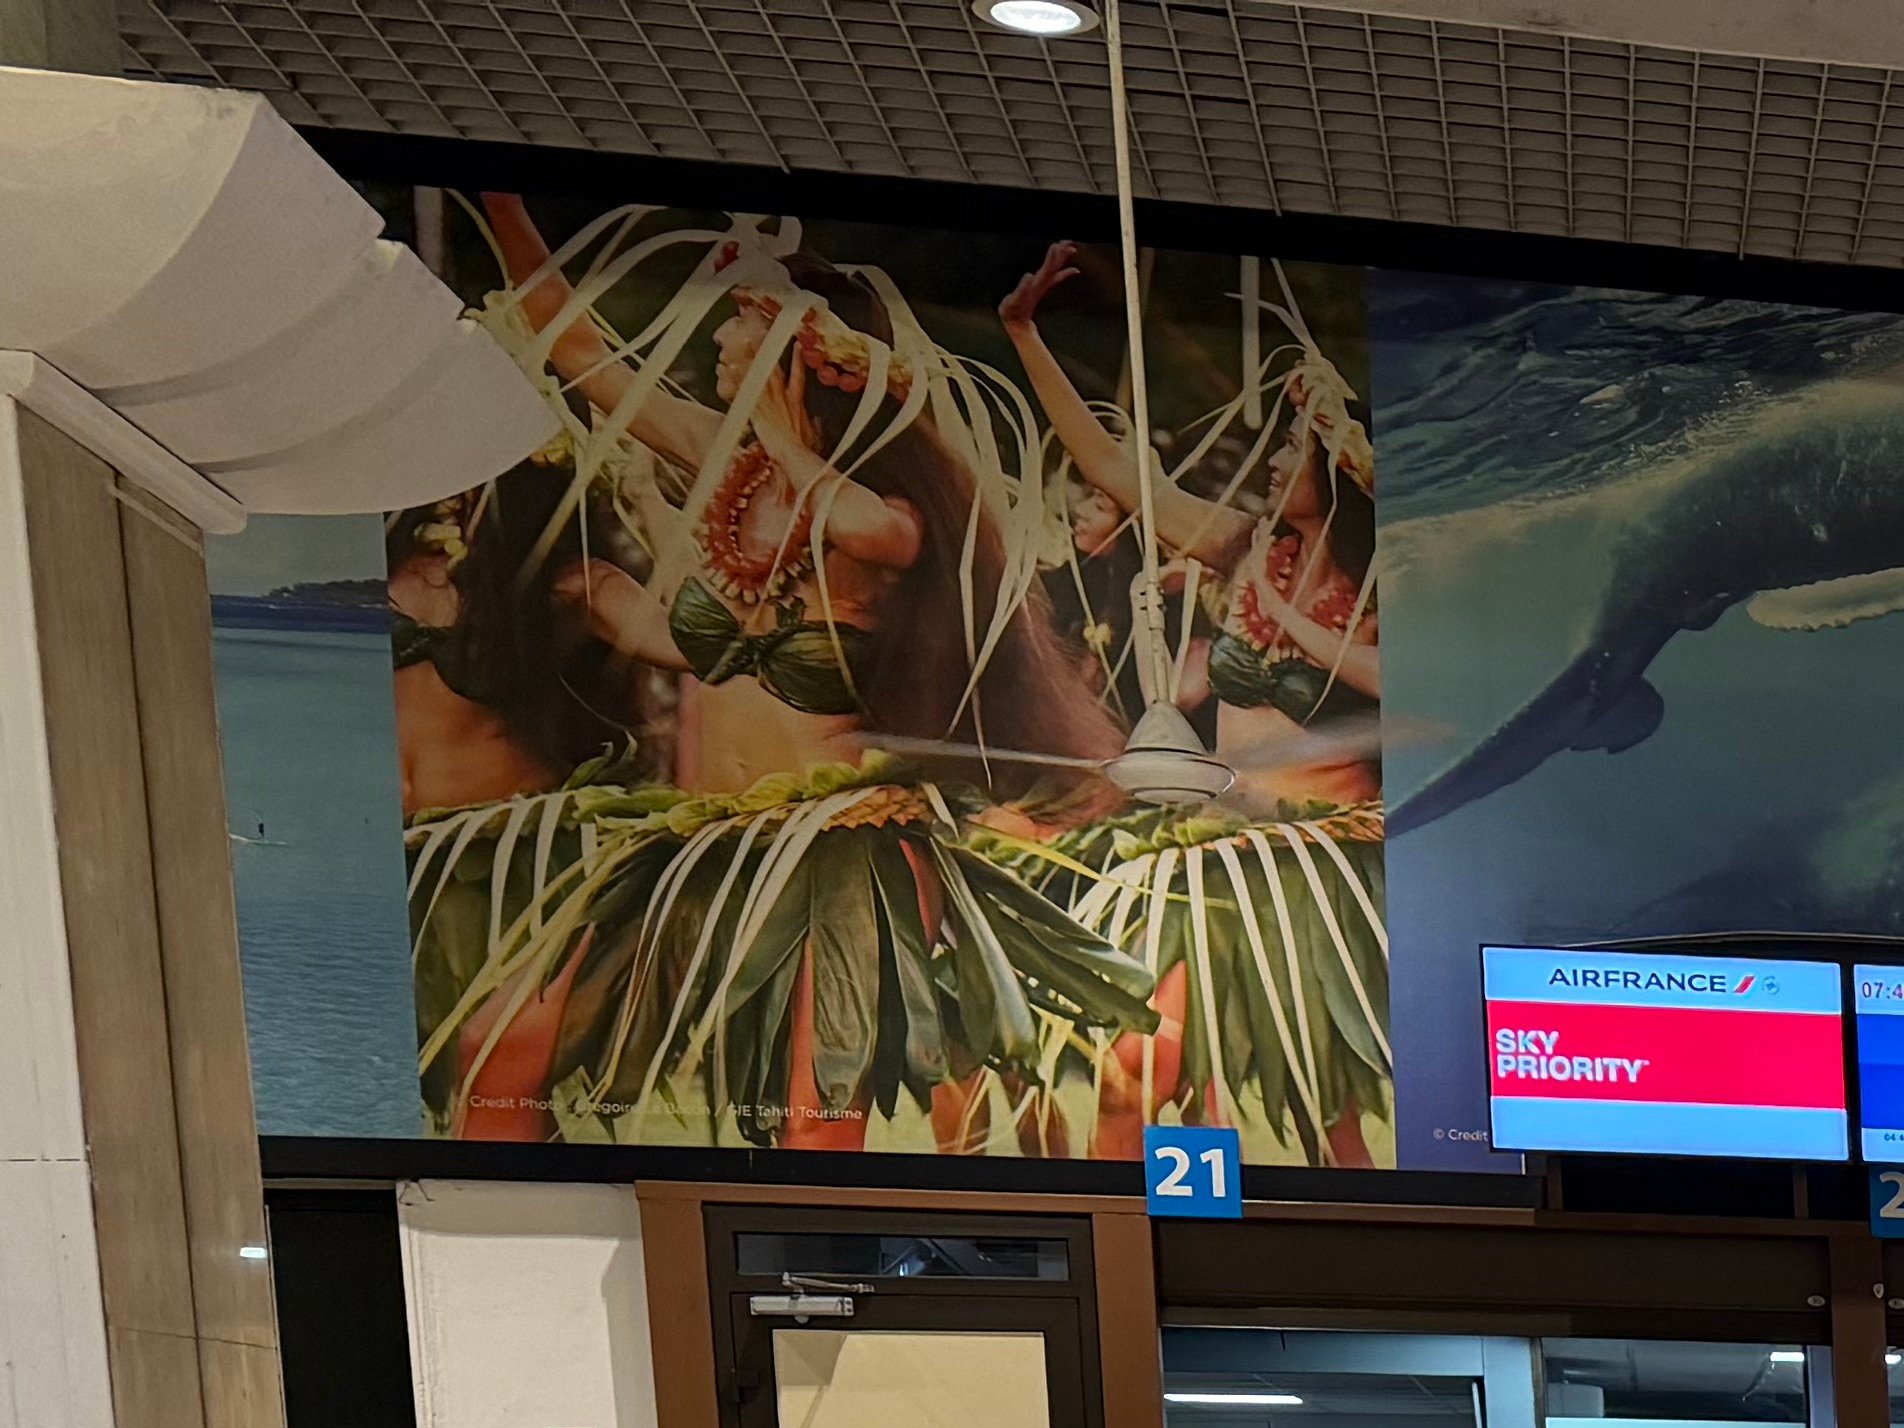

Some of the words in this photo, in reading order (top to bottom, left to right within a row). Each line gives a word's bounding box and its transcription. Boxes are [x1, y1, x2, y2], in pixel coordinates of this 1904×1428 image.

[1548, 968, 1728, 993] AIRFRANCE
[1495, 1027, 1560, 1055] SKY
[755, 1105, 794, 1119] Tahiti
[799, 1106, 863, 1121] Tourisme
[1154, 1146, 1227, 1198] 21
